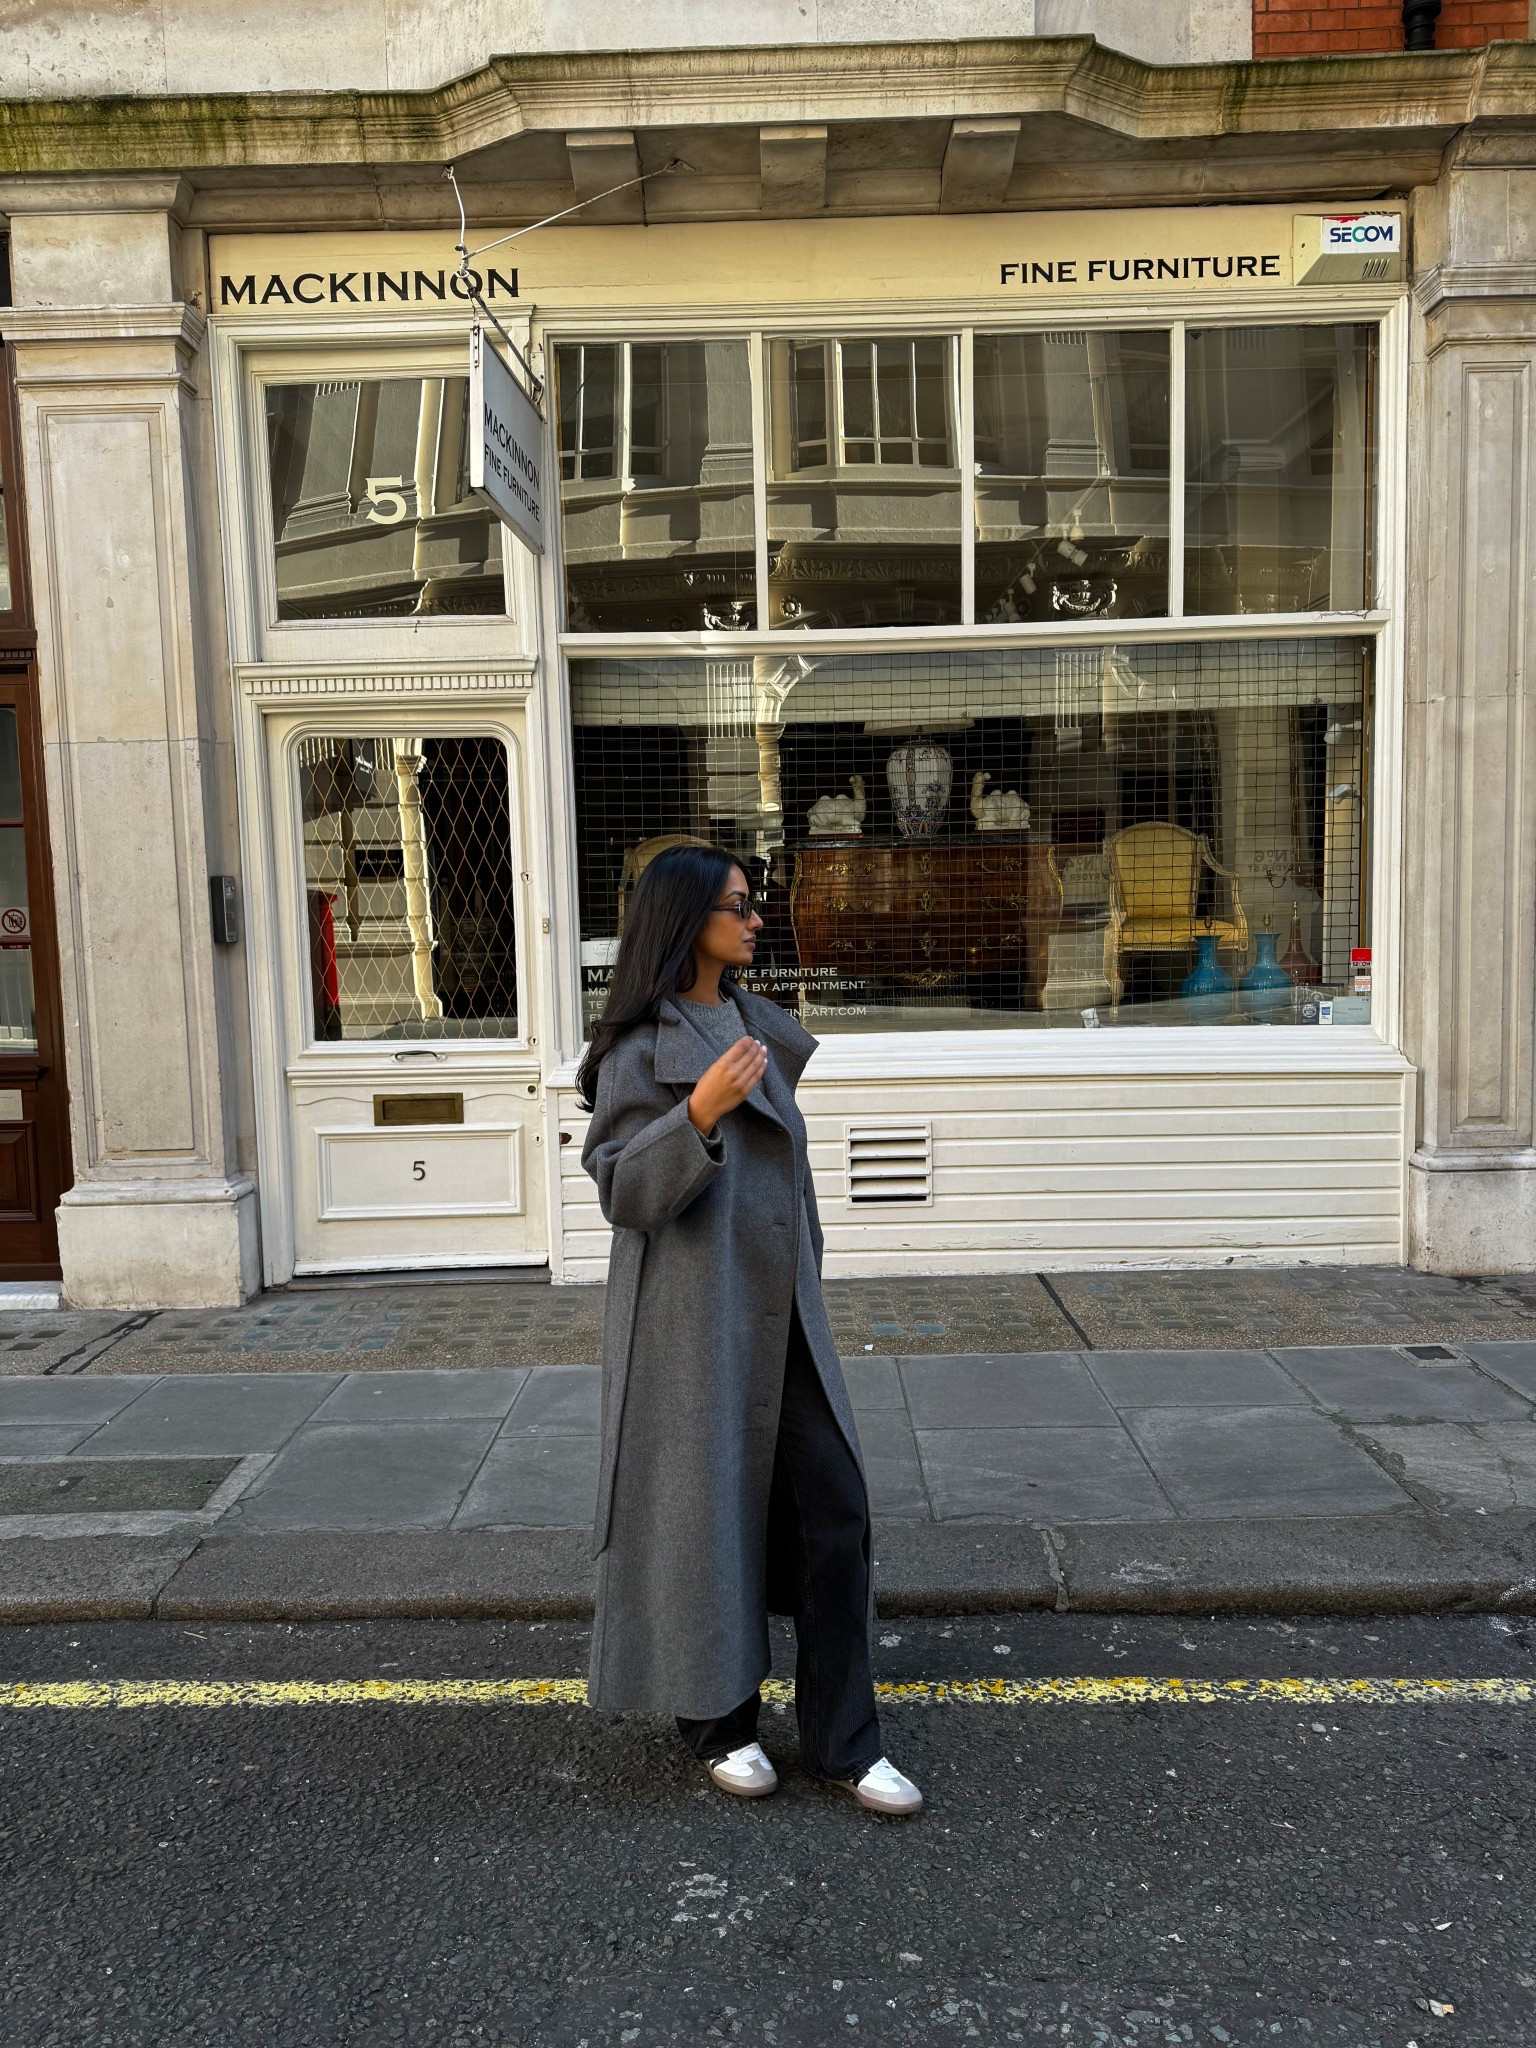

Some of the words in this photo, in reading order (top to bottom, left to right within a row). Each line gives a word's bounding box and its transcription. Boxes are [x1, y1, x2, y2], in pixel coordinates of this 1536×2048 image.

[1330, 226, 1393, 242] SECOM
[1000, 260, 1077, 285] FINE
[1088, 255, 1280, 282] FURNITURE
[220, 268, 520, 305] MACKINNON
[484, 401, 540, 492] MACKINNON
[484, 442, 502, 478] FINE
[503, 465, 540, 522] FURNITURE
[365, 475, 407, 525] 5
[760, 967, 838, 979] FURNITURE
[752, 983, 769, 992] BY
[772, 980, 866, 992] APPOINTMENT
[784, 1007, 867, 1017] INEART.COM
[412, 1160, 426, 1181] 5
